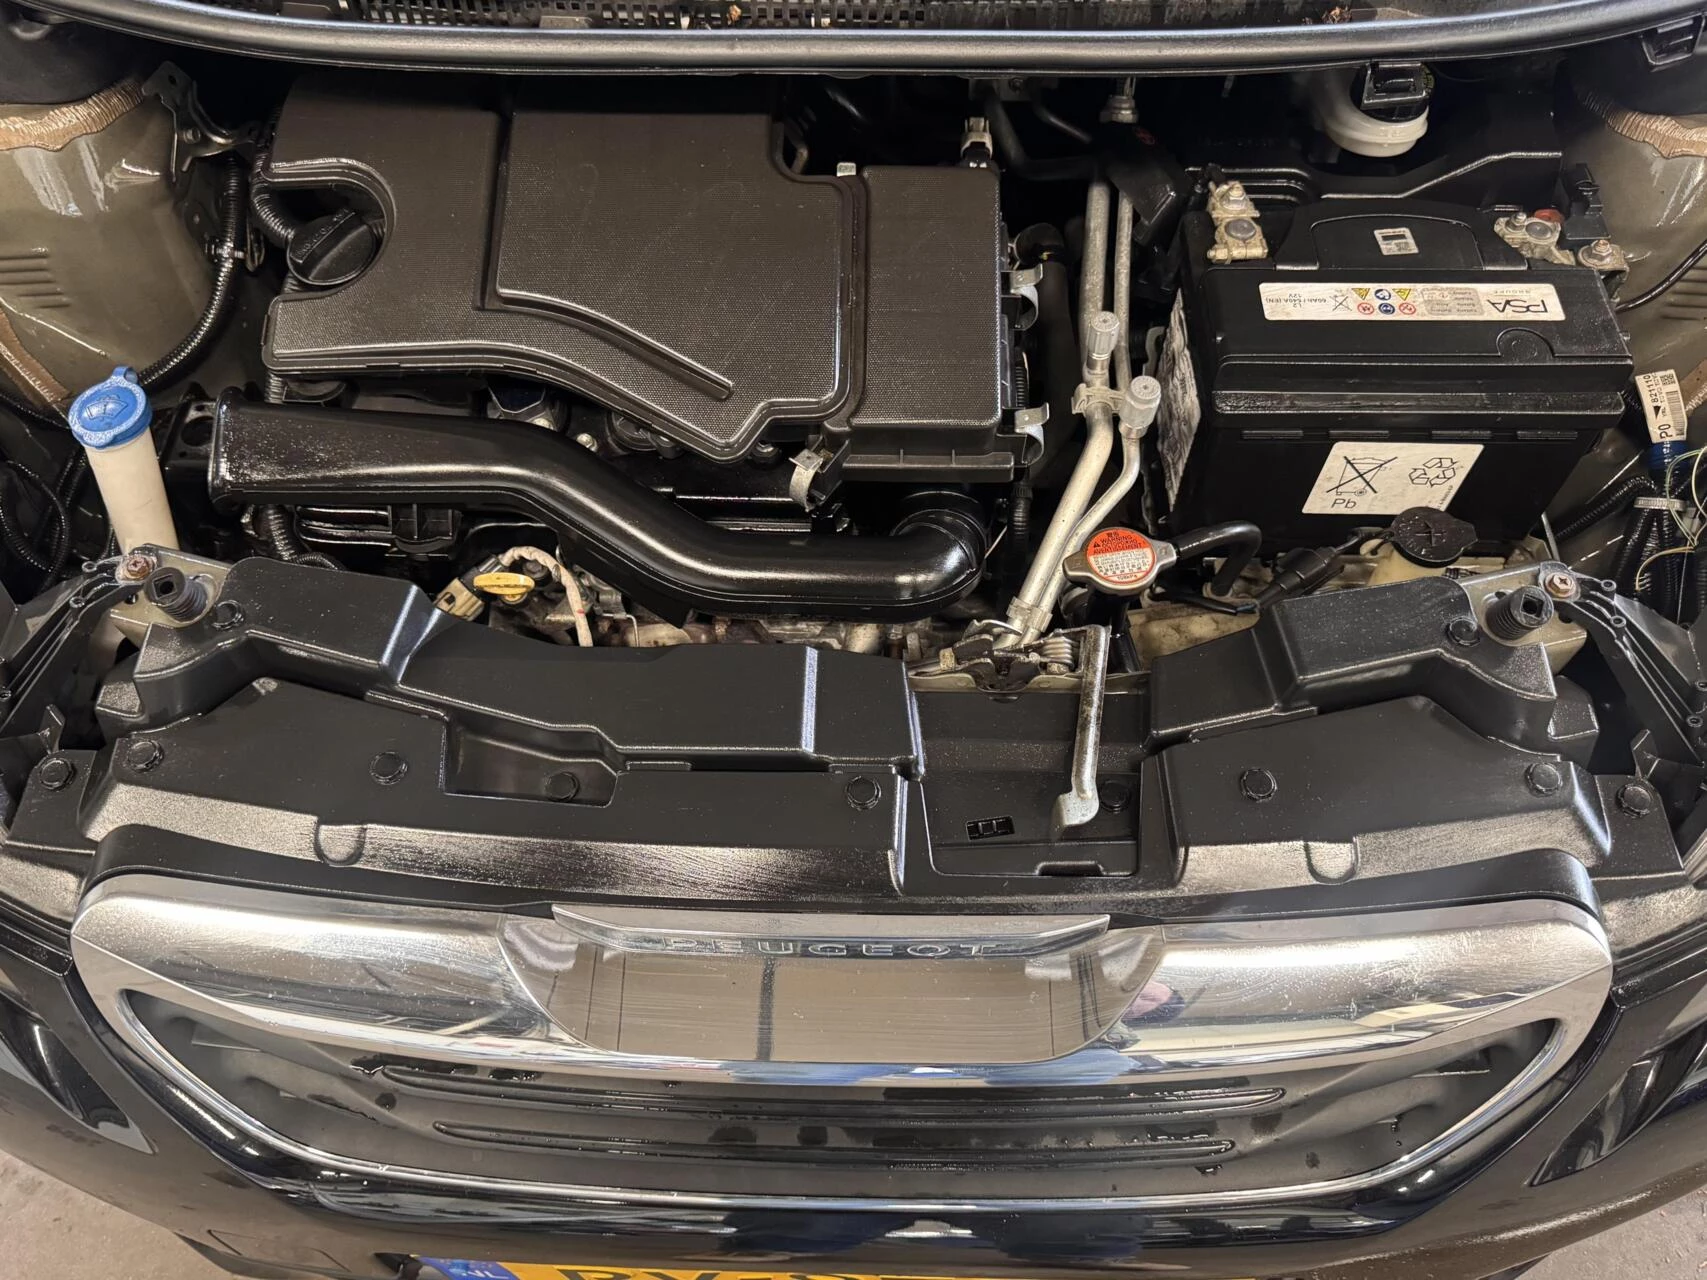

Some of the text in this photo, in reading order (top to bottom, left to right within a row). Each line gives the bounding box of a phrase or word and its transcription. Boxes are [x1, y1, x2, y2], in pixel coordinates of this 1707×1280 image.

[1486, 299, 1549, 314] PSA
[1331, 498, 1357, 509] Pb
[662, 936, 997, 957] PEUGEOT
